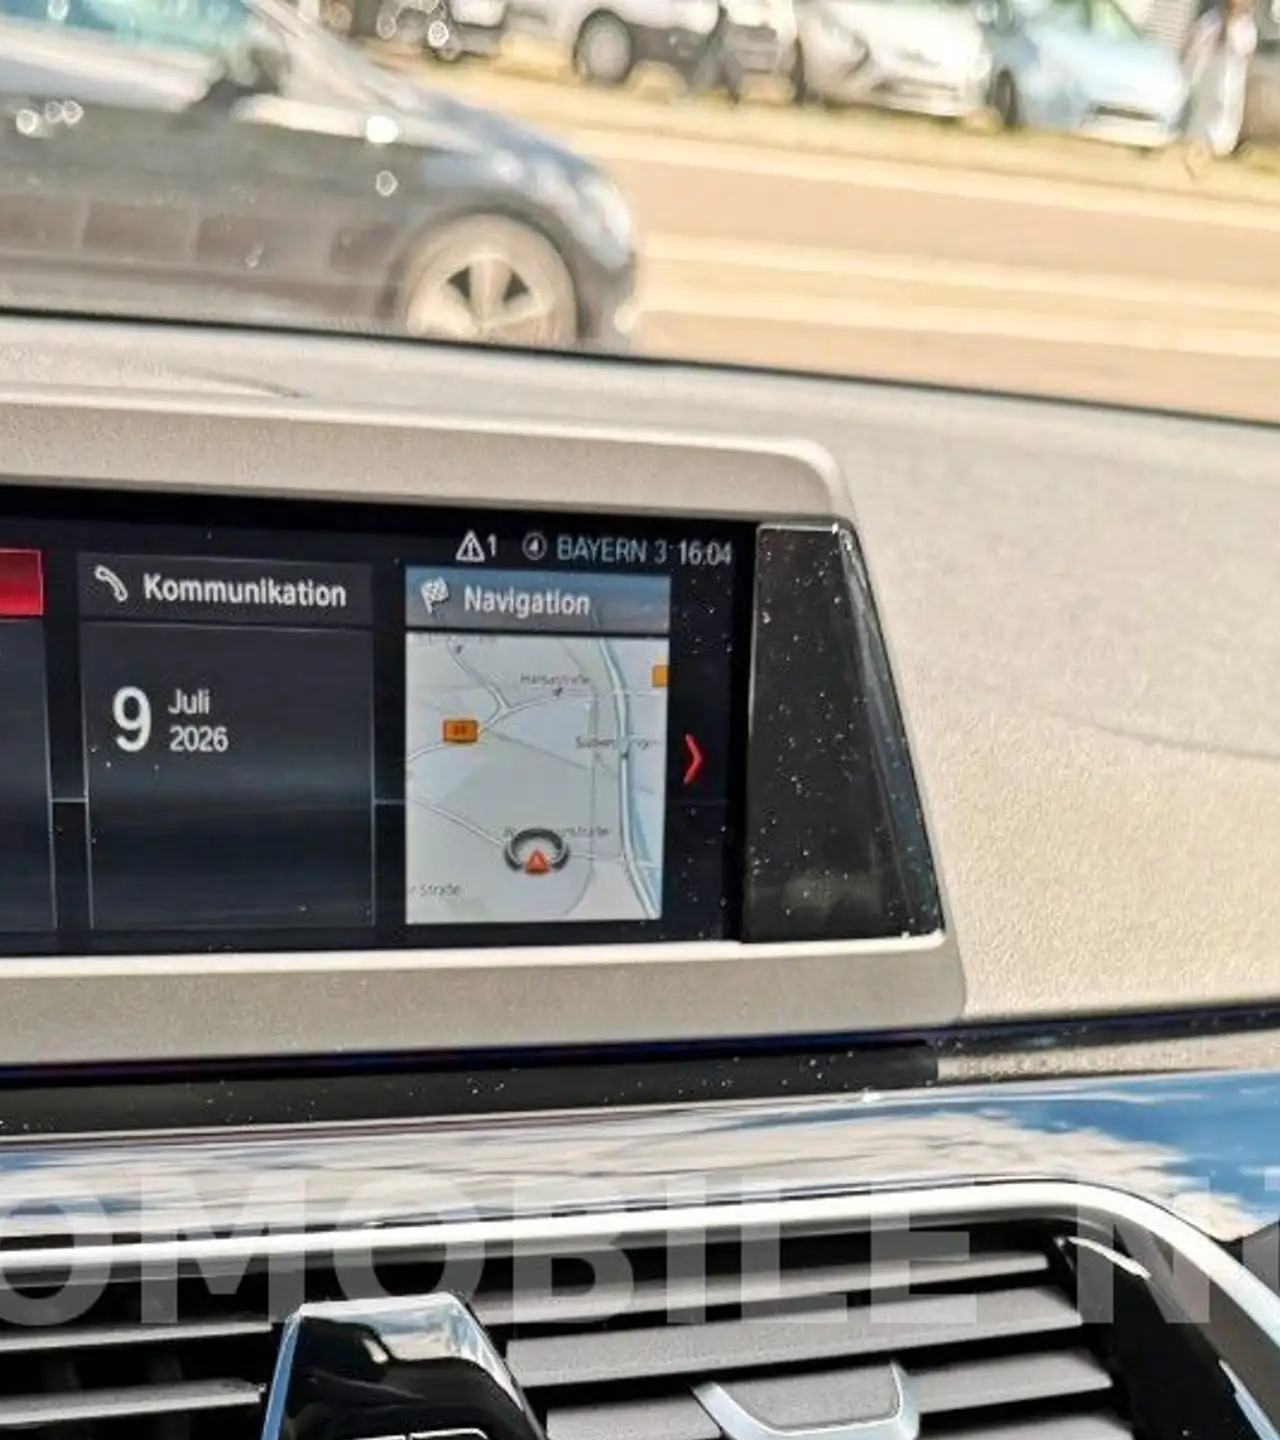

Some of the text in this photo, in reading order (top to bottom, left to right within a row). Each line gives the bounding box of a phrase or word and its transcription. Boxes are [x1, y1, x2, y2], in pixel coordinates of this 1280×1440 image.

[556, 534, 668, 564] BAYERN 3
[678, 539, 733, 565] 16:04
[142, 572, 348, 608] Kommunikation
[463, 585, 593, 618] Navigation
[168, 688, 211, 716] Juli
[112, 686, 152, 753] 9
[169, 725, 230, 754] 2026
